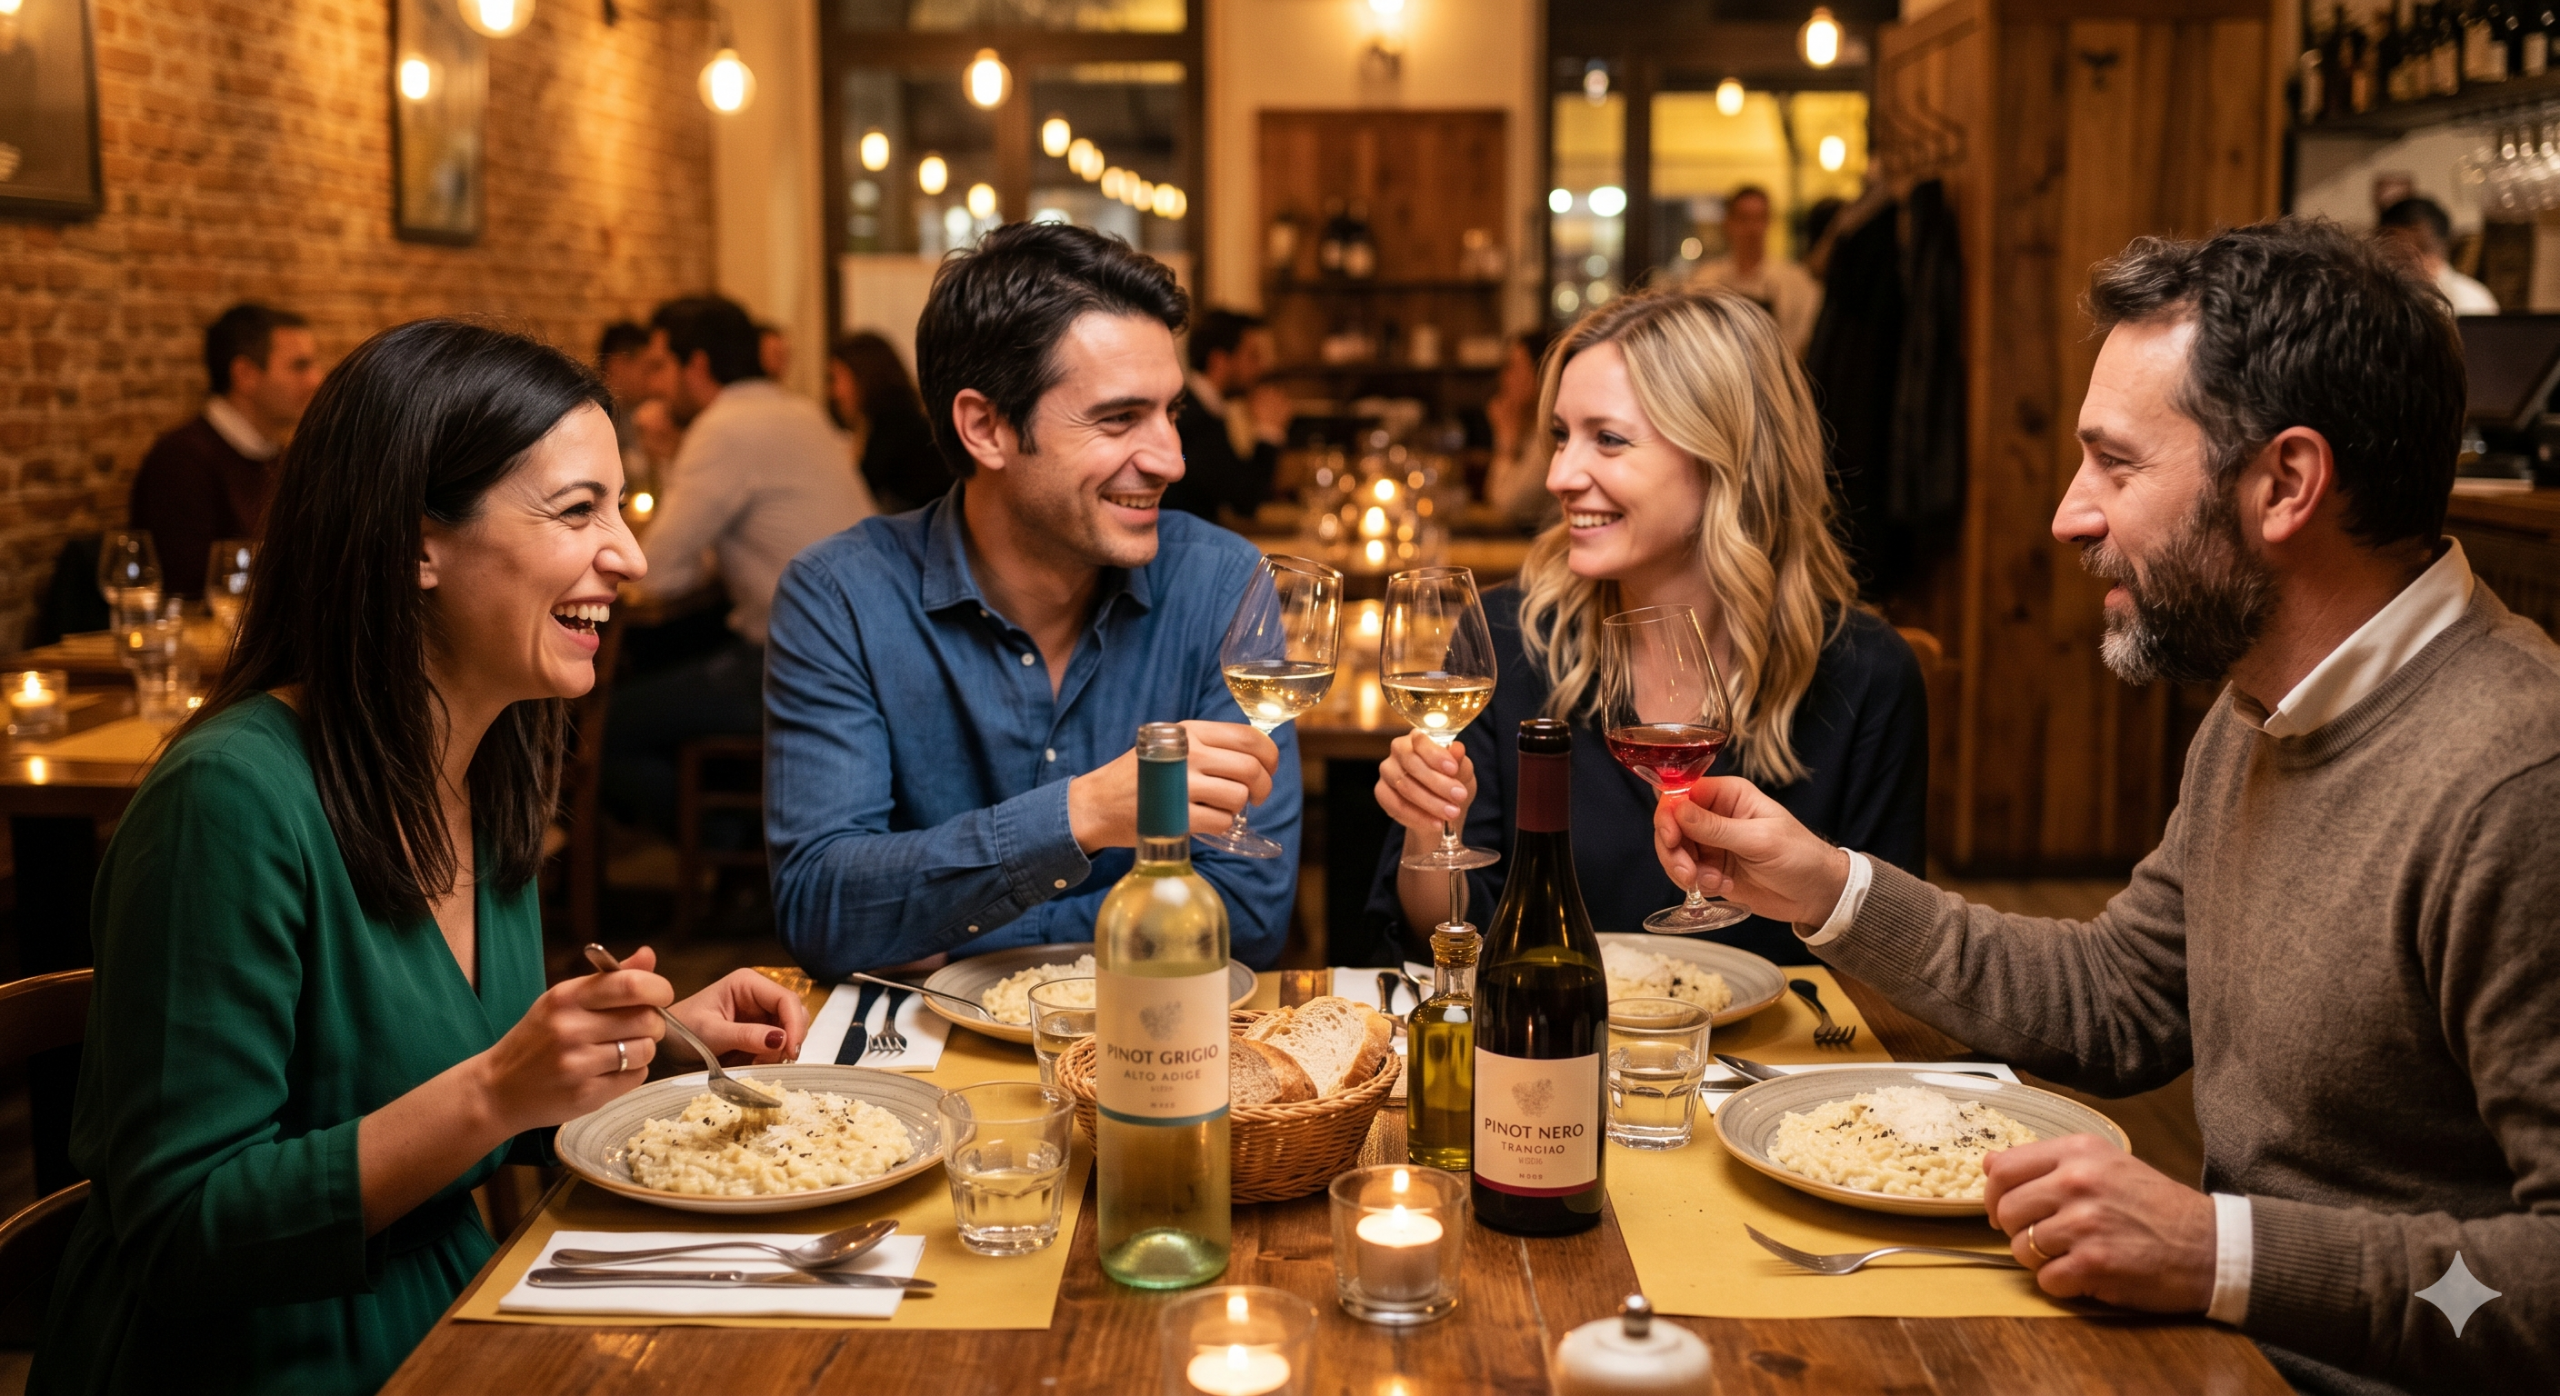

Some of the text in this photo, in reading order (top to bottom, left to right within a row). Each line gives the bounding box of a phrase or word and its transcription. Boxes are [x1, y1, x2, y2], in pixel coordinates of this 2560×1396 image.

[1107, 1043, 1219, 1065] PINOT GRIGIO
[1123, 1069, 1201, 1081] ALTO ADIGE
[1484, 1117, 1584, 1139] PINOT NERO
